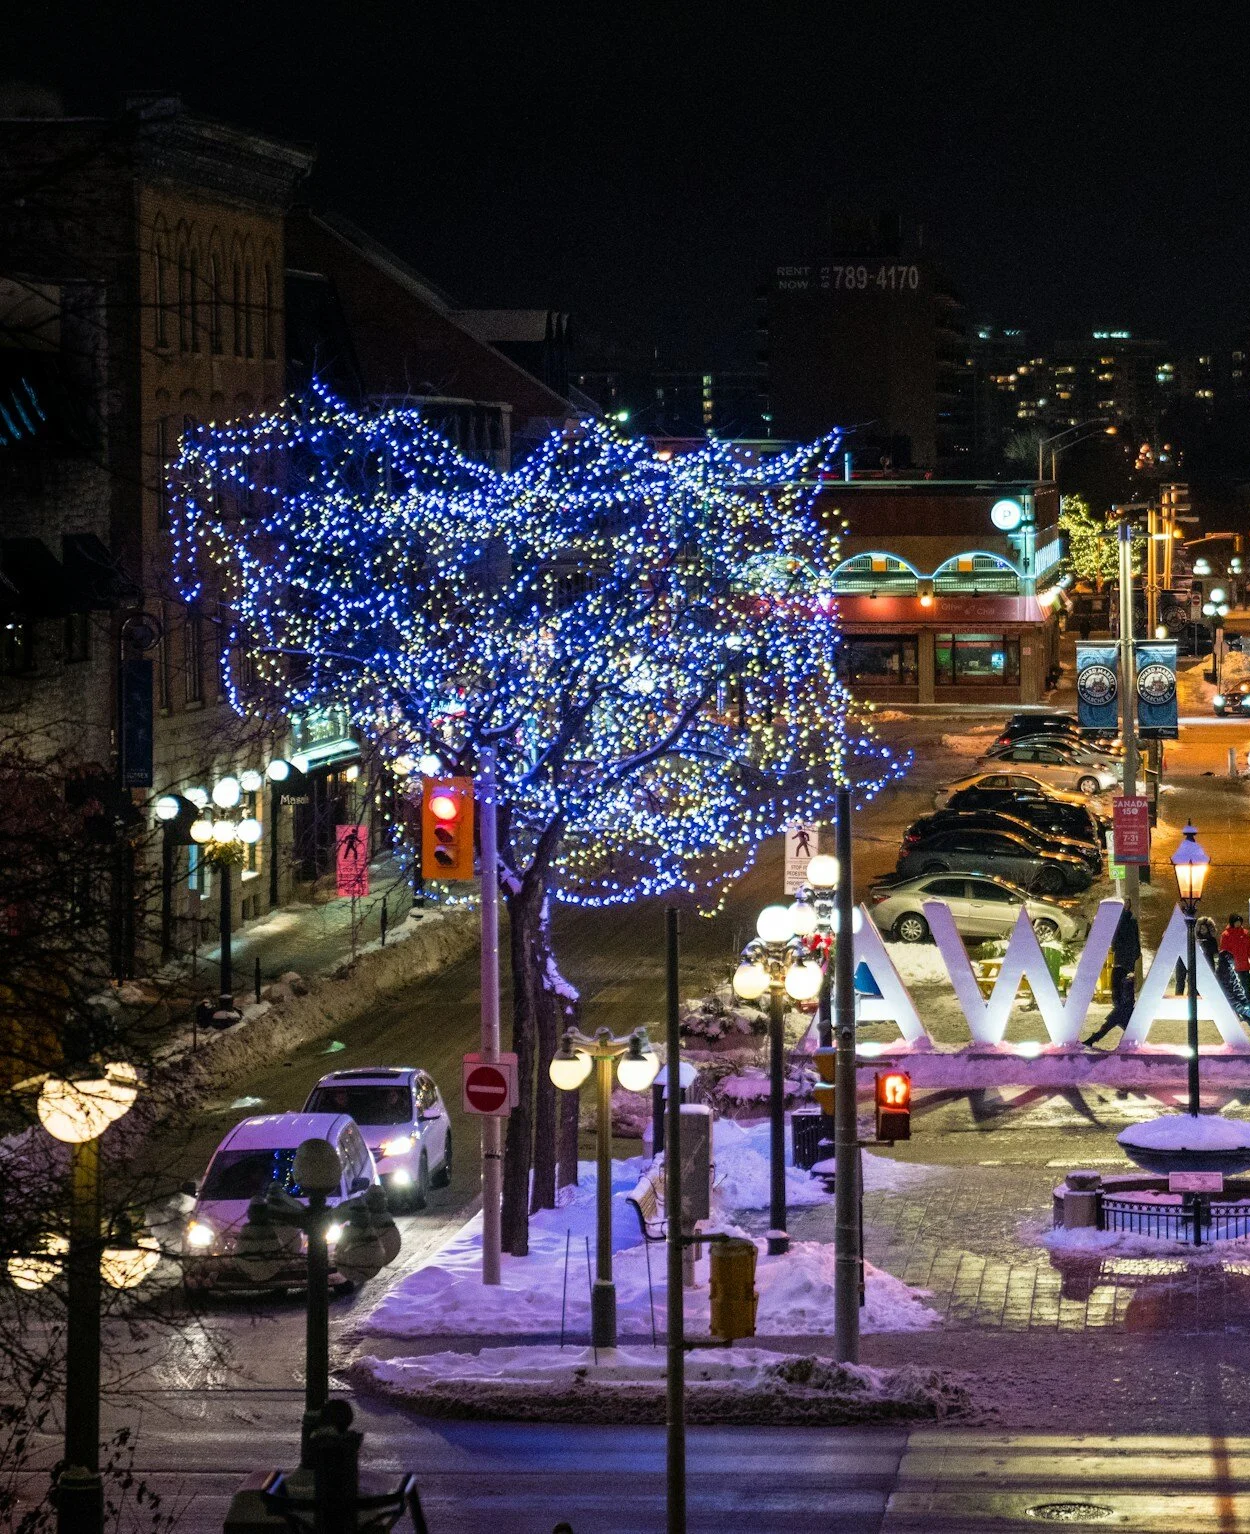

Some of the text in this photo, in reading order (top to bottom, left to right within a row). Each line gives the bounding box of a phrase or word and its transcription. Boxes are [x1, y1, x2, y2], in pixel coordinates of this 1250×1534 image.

[776, 266, 811, 276] RENT
[833, 265, 920, 290] 789-4170
[778, 280, 809, 289] NOW
[1113, 800, 1149, 808] CANADA
